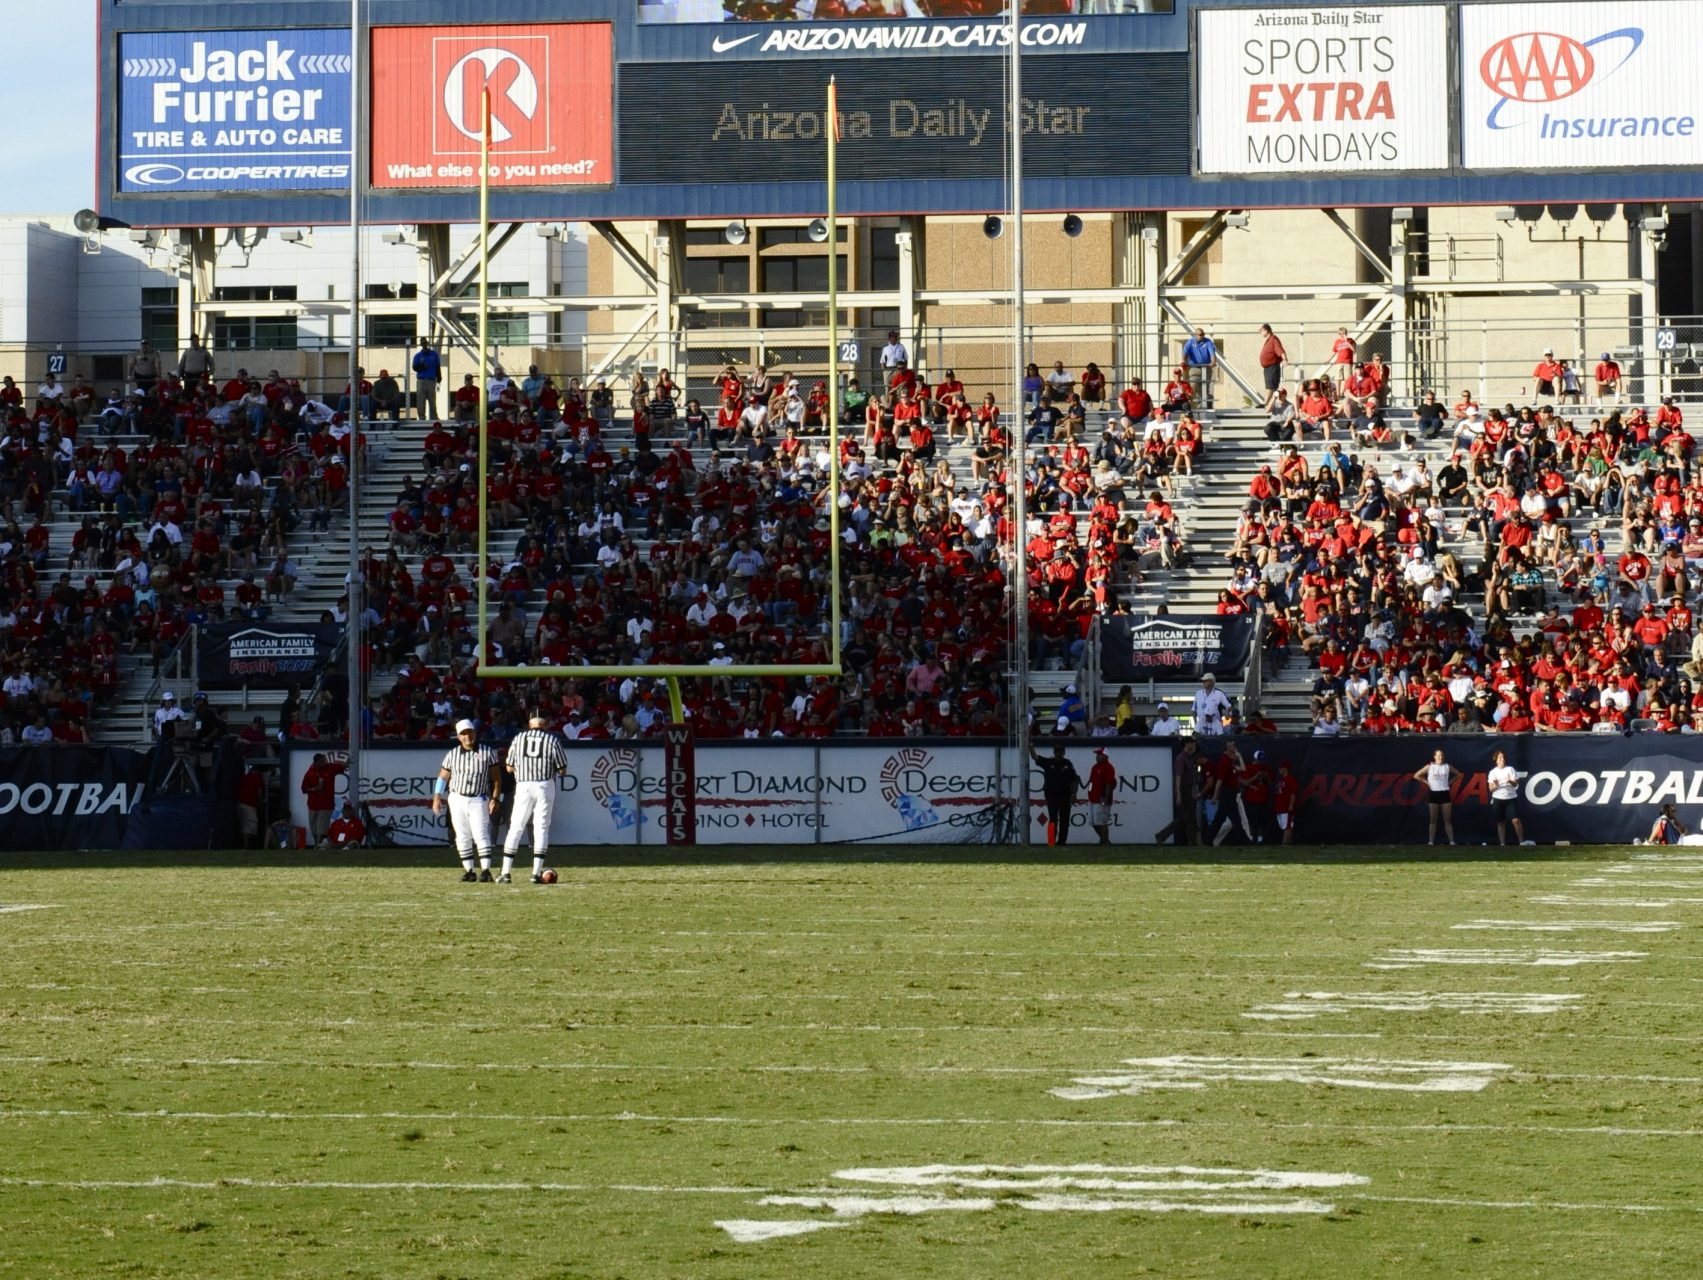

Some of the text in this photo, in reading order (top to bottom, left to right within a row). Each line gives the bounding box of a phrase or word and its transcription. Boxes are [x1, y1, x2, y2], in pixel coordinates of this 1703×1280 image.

[1254, 10, 1384, 27] Arizona Daily Star
[180, 40, 296, 83] Jack
[1243, 35, 1395, 76] SPORTS
[1485, 37, 1589, 100] AAA
[153, 82, 323, 124] Furrier
[1246, 80, 1396, 123] EXTRA
[890, 98, 991, 147] Daily
[1540, 113, 1695, 139] Insurance
[132, 127, 343, 148] TIRE & AUTO CARE
[1248, 131, 1398, 164] MONDAYS
[387, 163, 433, 179] What
[437, 162, 474, 178] else
[504, 163, 537, 181] you
[540, 159, 594, 176] need?
[1658, 329, 1675, 349] 29
[49, 354, 64, 373] 27
[841, 343, 858, 362] 28
[230, 638, 315, 648] AMERICAN FAMILY
[1133, 630, 1221, 639] AMERICAN FAMILY
[236, 648, 308, 656] INSURANCE
[526, 736, 542, 757] U
[667, 730, 687, 840] WILDCATS
